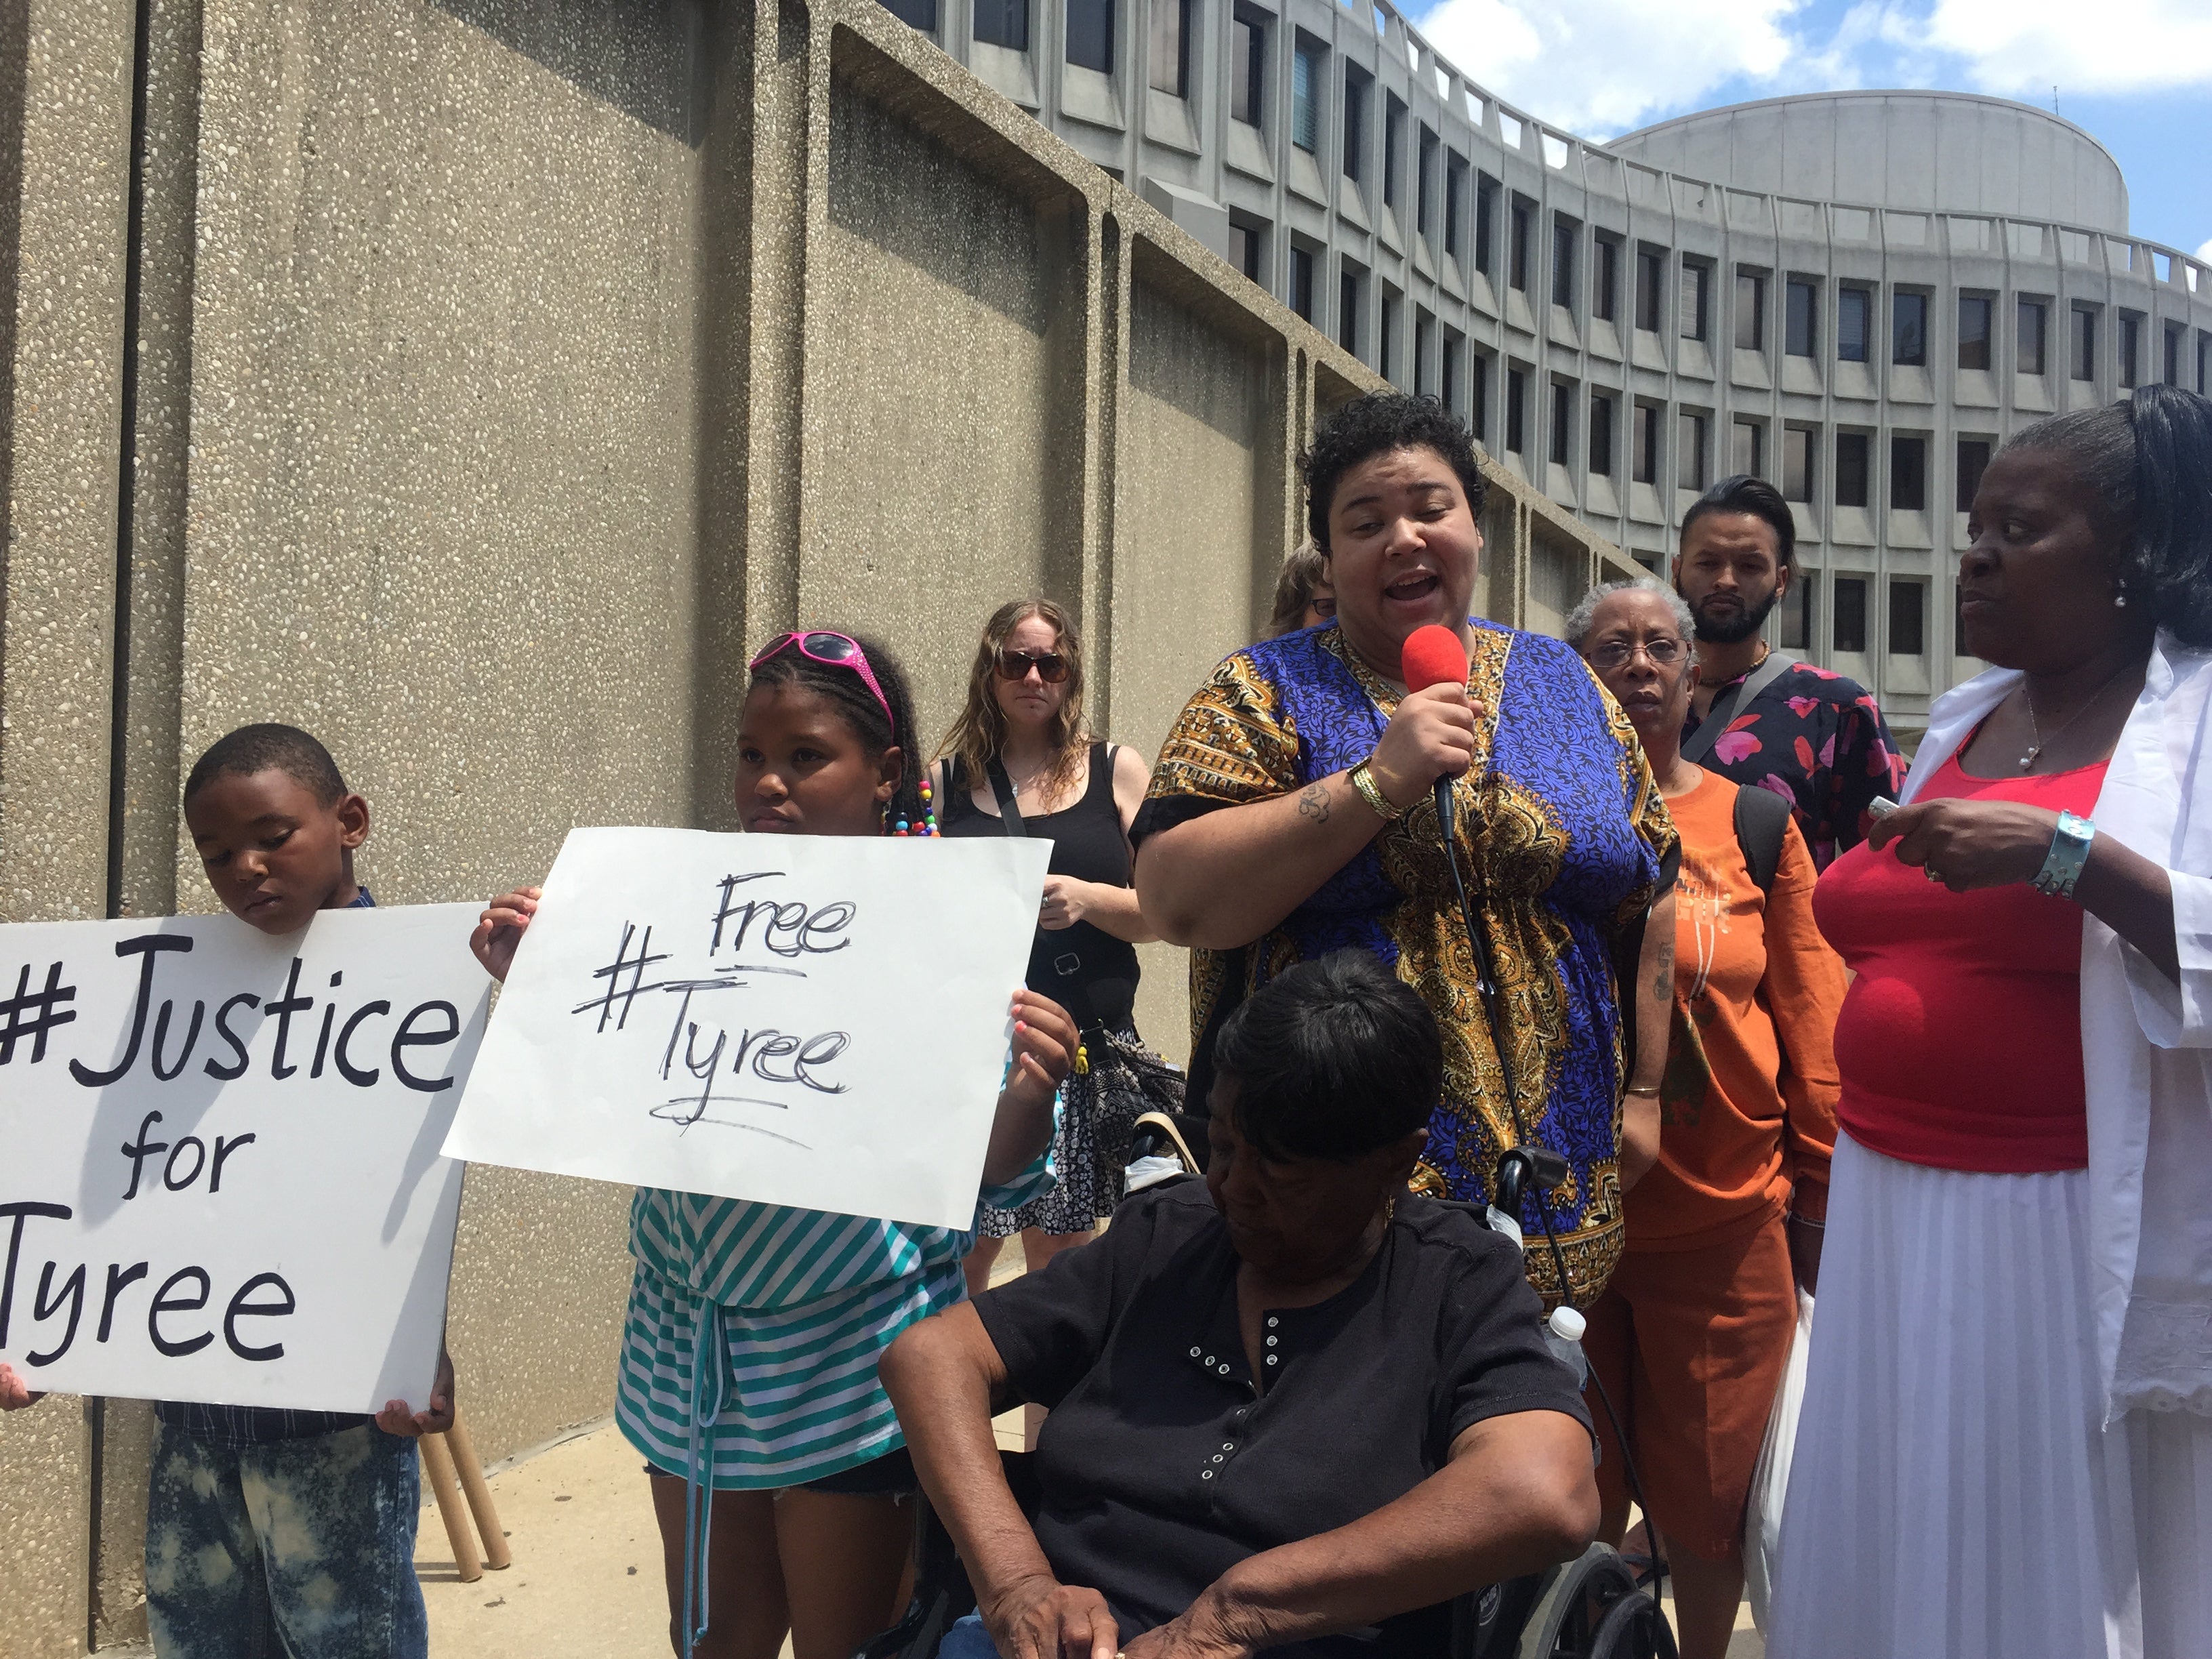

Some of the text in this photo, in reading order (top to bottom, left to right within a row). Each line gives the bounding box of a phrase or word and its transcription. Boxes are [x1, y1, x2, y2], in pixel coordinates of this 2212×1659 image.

[709, 872, 857, 957] Free
[0, 934, 460, 1092] #Justice
[121, 1110, 256, 1200] for
[0, 1201, 295, 1368] Tyree
